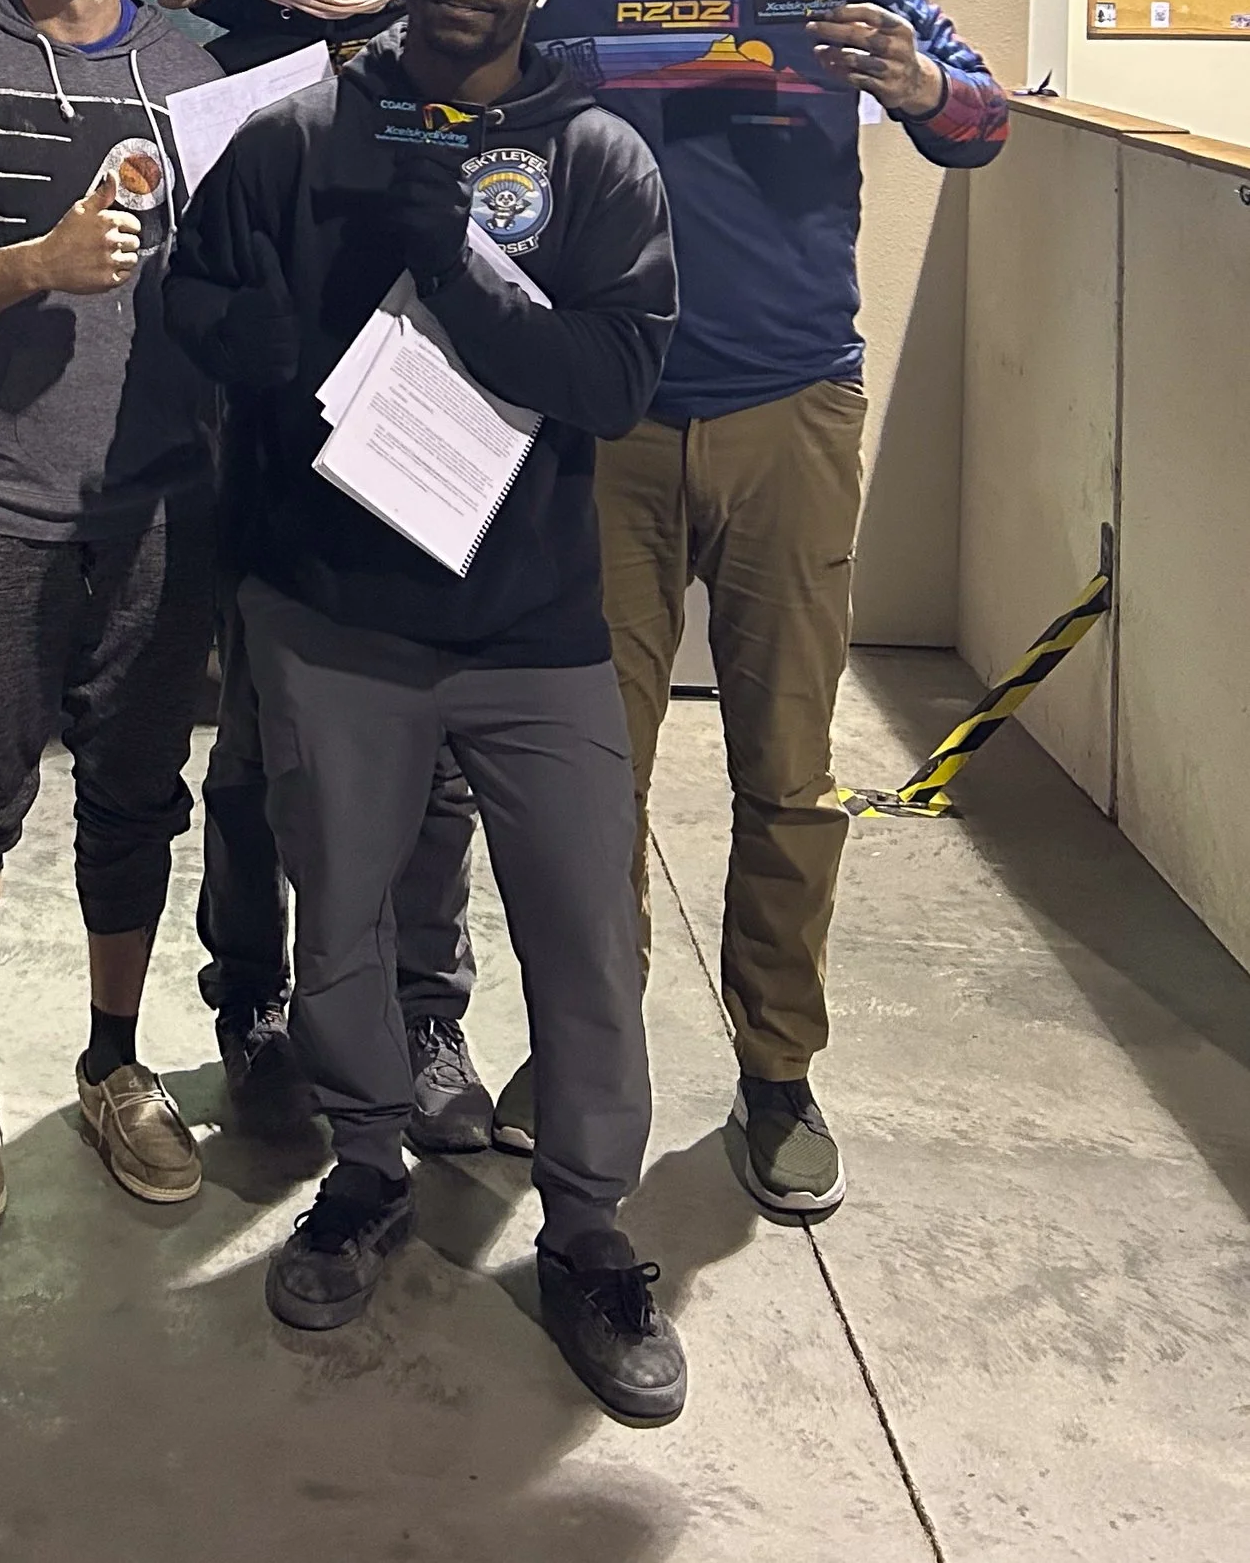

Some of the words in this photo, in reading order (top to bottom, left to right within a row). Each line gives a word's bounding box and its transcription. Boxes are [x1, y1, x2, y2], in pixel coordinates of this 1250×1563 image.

[380, 99, 417, 112] COACH
[466, 152, 499, 173] SKY
[501, 150, 547, 174] LEVEL
